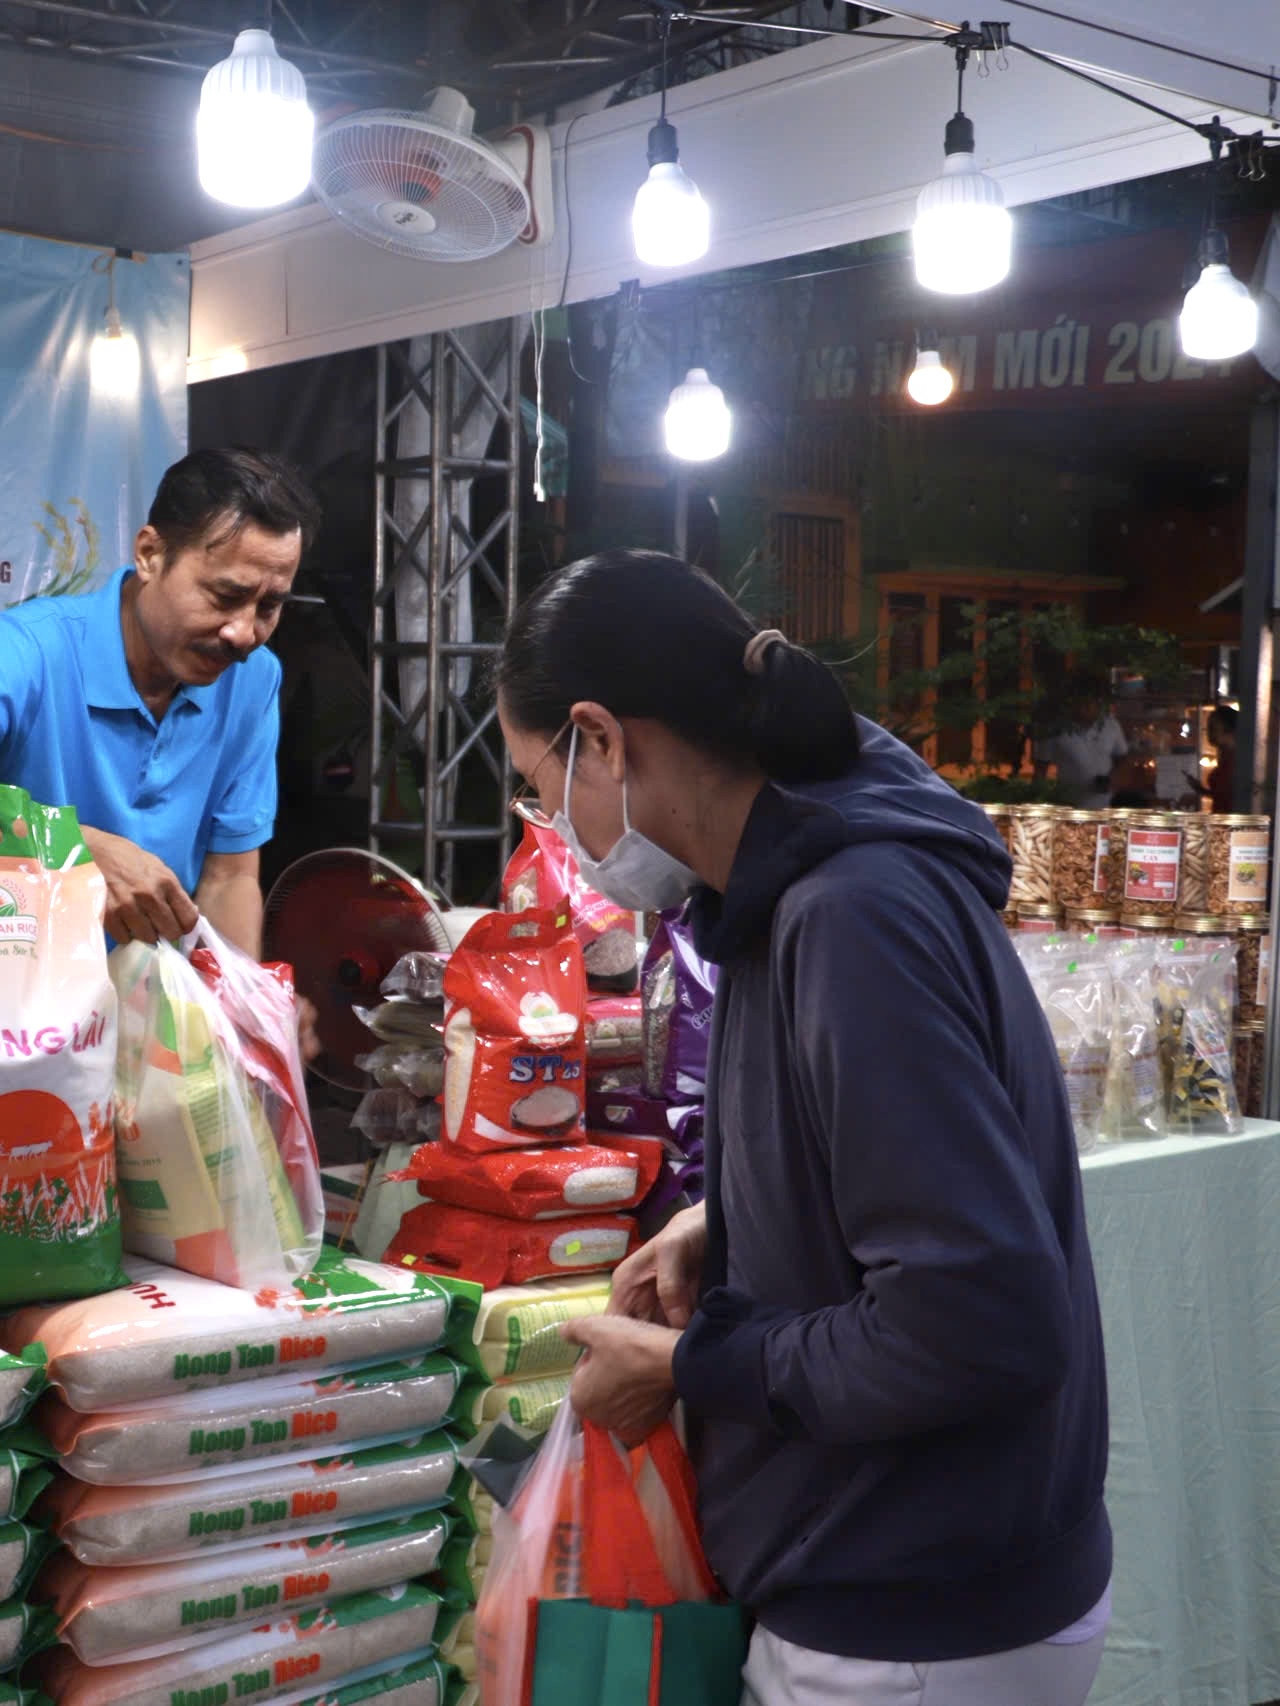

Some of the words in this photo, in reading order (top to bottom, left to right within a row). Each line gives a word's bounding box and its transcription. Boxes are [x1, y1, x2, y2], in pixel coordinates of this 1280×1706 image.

[993, 315, 1088, 391] MỚI
[236, 1343, 276, 1369] Tan
[279, 1335, 328, 1364] Rice
[250, 1419, 288, 1446] Tan
[291, 1410, 338, 1439] Rice
[250, 1499, 288, 1526] Tan
[290, 1489, 338, 1519] Rice
[241, 1583, 280, 1611] Tan
[283, 1571, 330, 1601] Rice
[232, 1668, 270, 1698] Tan
[274, 1652, 321, 1686] Rice
